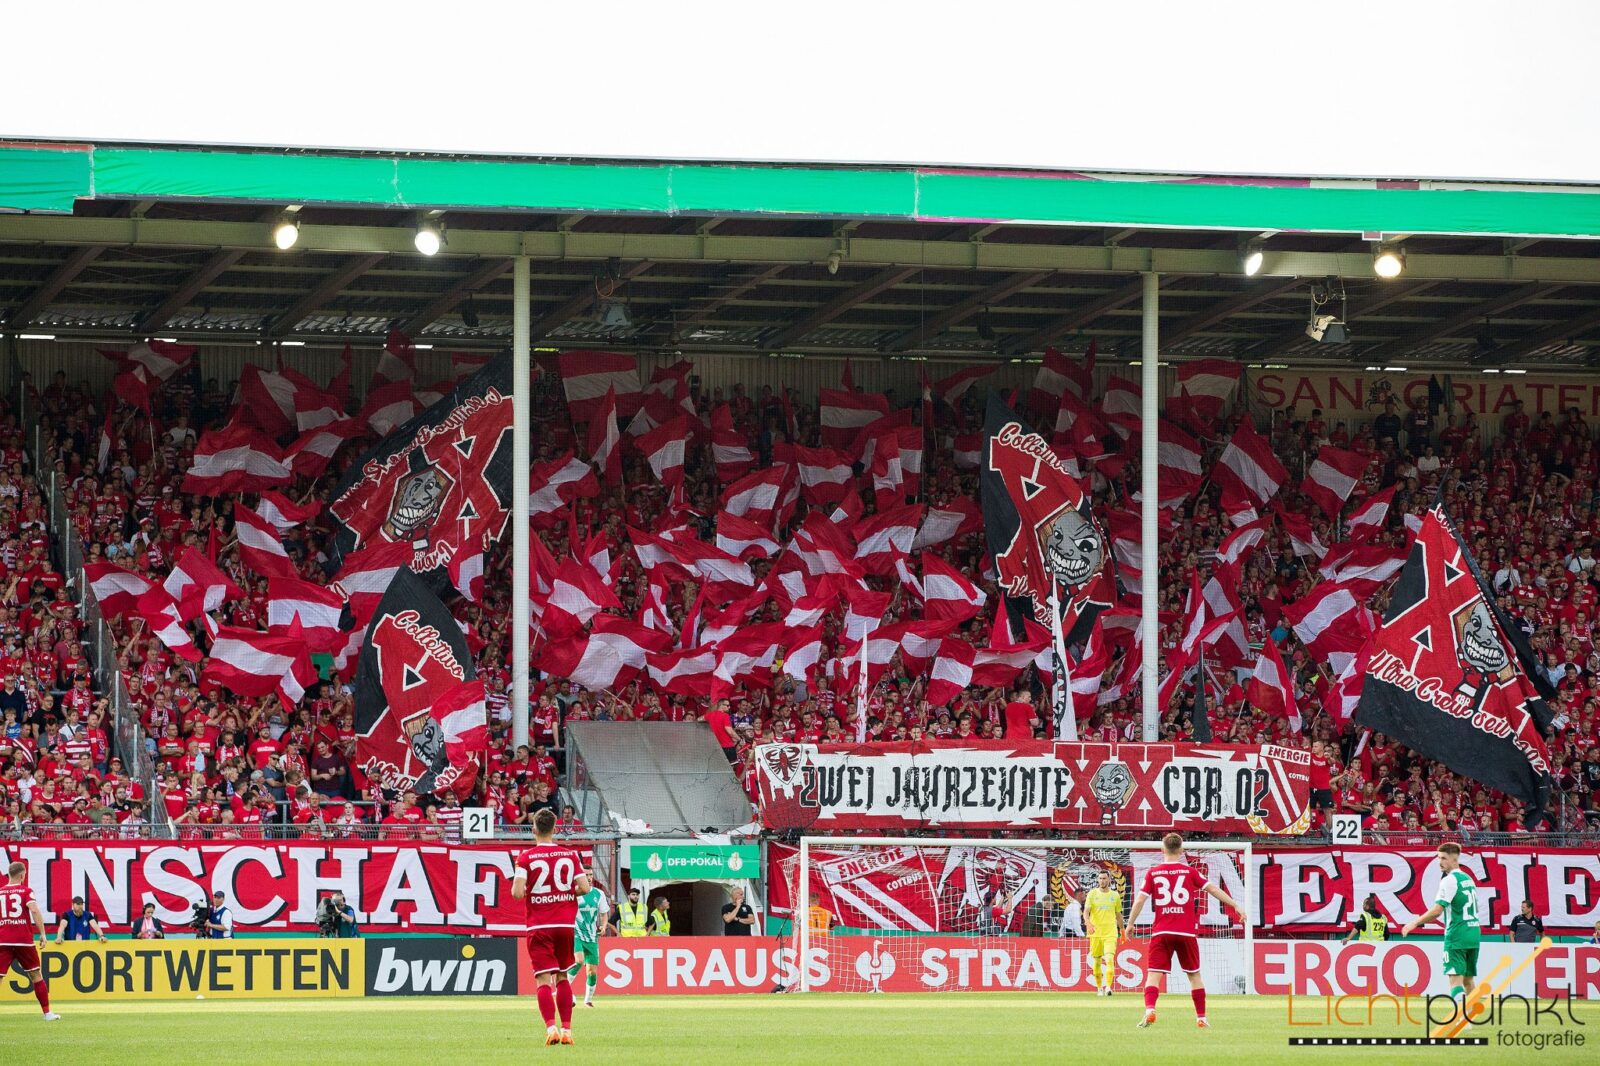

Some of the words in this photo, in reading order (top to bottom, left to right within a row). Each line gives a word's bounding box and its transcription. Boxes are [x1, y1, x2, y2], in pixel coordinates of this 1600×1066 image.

[393, 610, 465, 682] Collettivo
[1365, 648, 1418, 692] Ultra
[1415, 676, 1473, 720] Crew
[1268, 746, 1310, 764] ENERGIE
[799, 764, 874, 811] ZWEI
[886, 764, 1071, 813] JAHRZEHNTE
[1163, 765, 1223, 820] CBR
[1235, 767, 1270, 816] 02
[469, 813, 489, 833] 21
[1336, 819, 1358, 839] 22
[529, 857, 575, 894] 20
[667, 857, 723, 867] DFB-POKAL
[886, 871, 924, 892] COTTBUS
[0, 845, 583, 928] INSCHAF
[0, 893, 23, 918] 13
[531, 894, 575, 904] BORGMANN
[1153, 875, 1190, 906] 36
[9, 948, 350, 994] SPORTWETTEN
[373, 944, 507, 993] bwin
[603, 947, 832, 989] STRAUSS
[920, 947, 1144, 988] STRAUSS
[1253, 943, 1432, 996] ERGO
